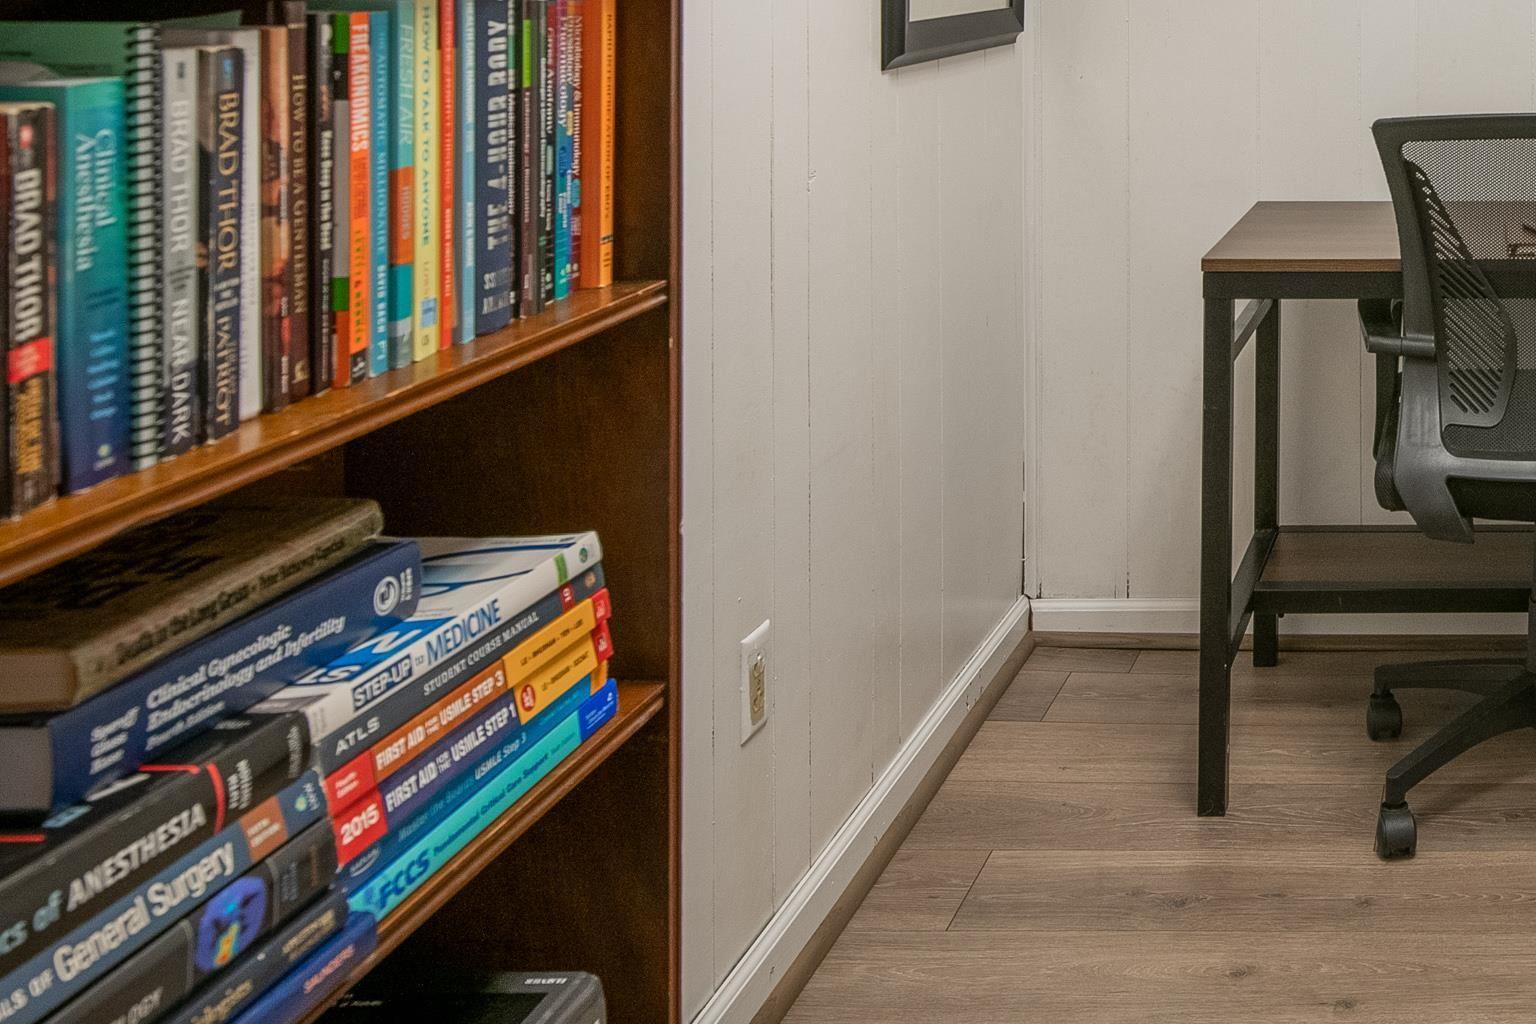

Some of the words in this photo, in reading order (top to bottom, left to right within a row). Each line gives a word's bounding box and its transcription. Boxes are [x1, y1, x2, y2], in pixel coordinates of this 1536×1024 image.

[399, 24, 414, 98] FRESH
[422, 5, 431, 51] HOW
[487, 20, 508, 86] BODY
[573, 15, 583, 88] Microbiology
[292, 74, 307, 123] HOW
[351, 24, 370, 152] FREAKONOMICS
[376, 54, 386, 146] AUTOMATIC
[422, 58, 430, 83] TO
[545, 68, 555, 134] Anatomy
[558, 15, 568, 128] Pharmacology
[170, 99, 192, 173] BRAD
[218, 91, 240, 175] BRAD
[293, 126, 305, 153] TO
[399, 106, 414, 145] AIR
[422, 90, 430, 133] TALK
[572, 103, 582, 176] Immunology
[95, 128, 117, 227] Clinical
[293, 159, 305, 179] BE
[422, 139, 430, 161] TO
[15, 168, 42, 255] BRAD
[75, 134, 100, 272] Anesthesia
[170, 180, 192, 254] THOR
[293, 182, 305, 195] A
[376, 151, 386, 257] MILLIONAIRE
[421, 169, 430, 247] ANYONE
[217, 178, 240, 273] THOR
[292, 200, 305, 314] GENTLEMAN
[487, 204, 508, 251] THE
[15, 253, 42, 343] THOR
[376, 264, 387, 299] DAVID
[171, 297, 191, 367] NEAR
[171, 370, 192, 445] DARK
[215, 317, 233, 428] PATRIOT
[146, 664, 208, 709] Clinical
[207, 624, 292, 677] Gynecologic
[146, 664, 255, 732] Endocrinology
[255, 643, 285, 673] and
[285, 615, 347, 657] Infertility
[335, 716, 380, 755] ATLS
[424, 656, 467, 696] STUDENT
[467, 638, 503, 669] COURSE
[502, 612, 539, 647] MANUAL
[354, 657, 413, 708] STEP-UP
[425, 598, 501, 666] MEDICINE
[438, 696, 472, 727] USMLE
[472, 682, 494, 705] STEP
[495, 670, 505, 687] 3
[451, 728, 485, 762] USMLE
[484, 709, 509, 738] STEP
[509, 702, 517, 718] 1
[375, 741, 406, 771] FIRST
[407, 727, 425, 753] AID
[474, 754, 502, 781] USMLE
[502, 740, 520, 760] Step
[520, 732, 527, 745] 3
[340, 803, 380, 845] 2015
[385, 782, 417, 812] FIRST
[418, 764, 438, 793] AID
[32, 889, 63, 932] of
[66, 803, 207, 912] ANESTHESIA
[379, 848, 431, 910] FCCS
[53, 894, 151, 982] General
[147, 842, 235, 916] Surgery
